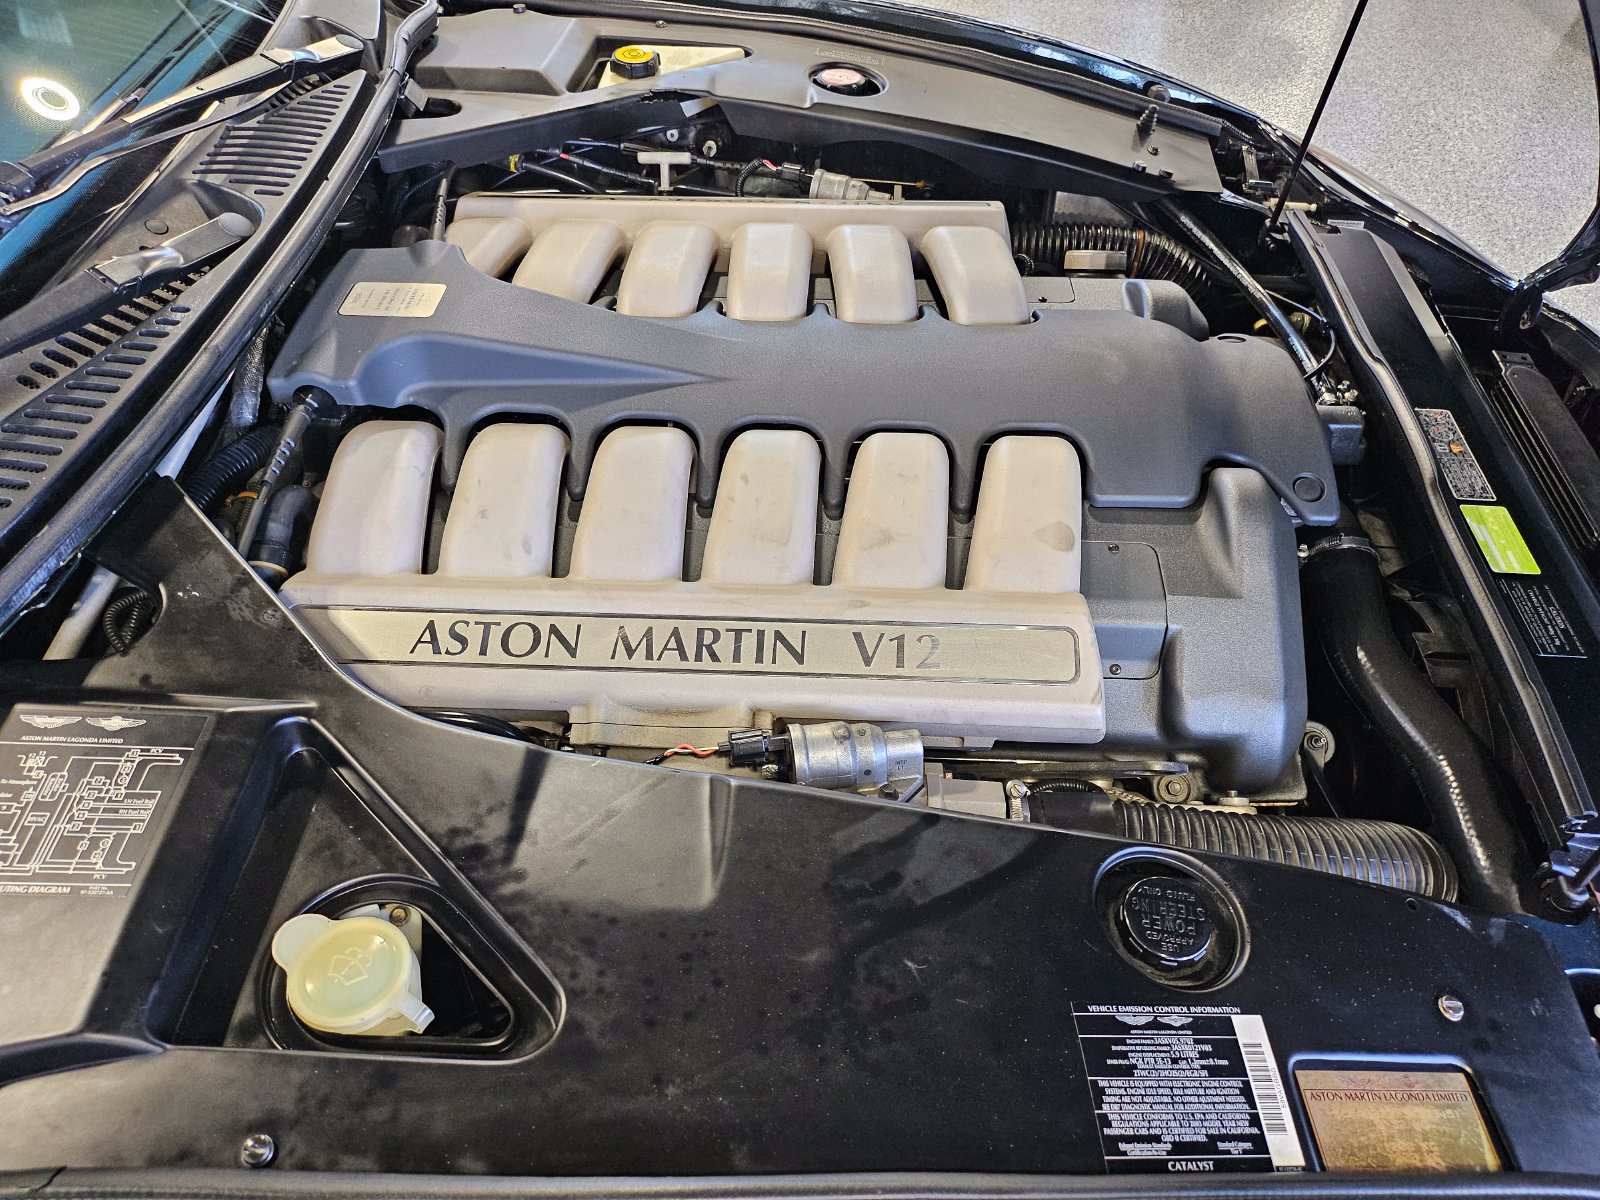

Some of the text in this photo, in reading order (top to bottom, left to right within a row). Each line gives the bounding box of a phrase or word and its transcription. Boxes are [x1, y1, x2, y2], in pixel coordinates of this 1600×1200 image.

[409, 619, 942, 670] ASTON MARTIN V12
[28, 886, 71, 894] DIAGRAM
[1138, 886, 1196, 902] FLUID ONLY
[1132, 896, 1205, 921] STEERING
[1142, 914, 1196, 936] POWER
[1146, 931, 1194, 946] APPROVED
[1161, 942, 1180, 952] USE
[1310, 1091, 1468, 1102] ASTON MARTIN LAGONDA LIMITED
[1168, 1161, 1214, 1171] CATALYST
